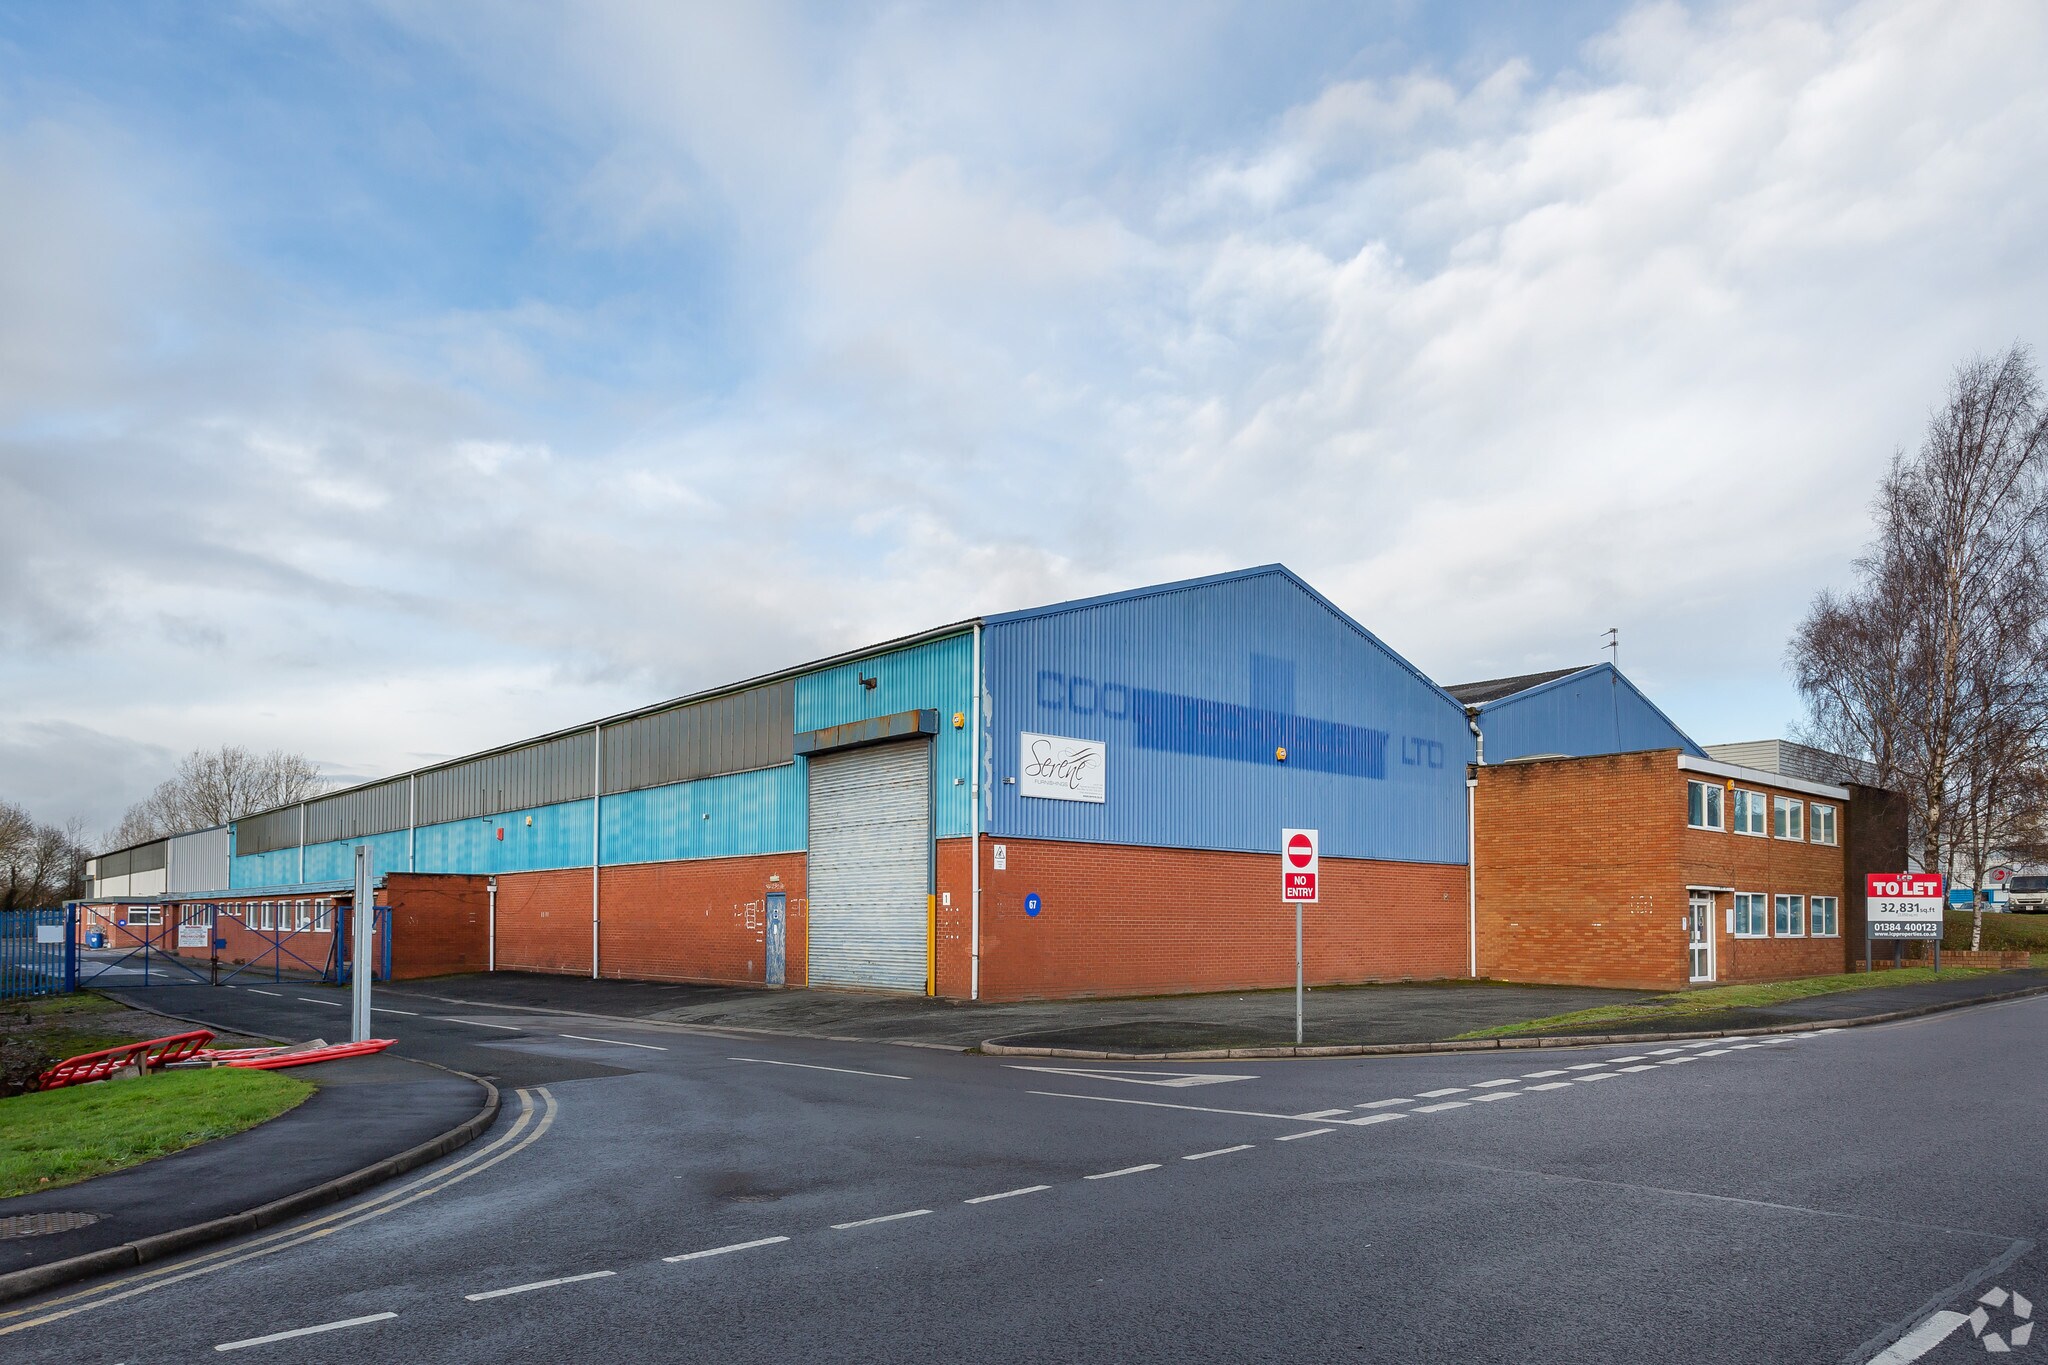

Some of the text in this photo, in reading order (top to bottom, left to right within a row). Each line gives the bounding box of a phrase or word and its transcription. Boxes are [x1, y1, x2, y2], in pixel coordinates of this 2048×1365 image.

[1402, 735, 1444, 769] LTD
[1025, 739, 1089, 790] Serene
[1034, 779, 1069, 788] FURNISHINGS
[1294, 875, 1307, 886] NO
[1287, 887, 1314, 897] ENTRY
[1872, 881, 1938, 896] TO LET
[1028, 900, 1037, 909] 67
[1880, 902, 1920, 914] 32,831
[1874, 923, 1937, 932] 01384 400123
